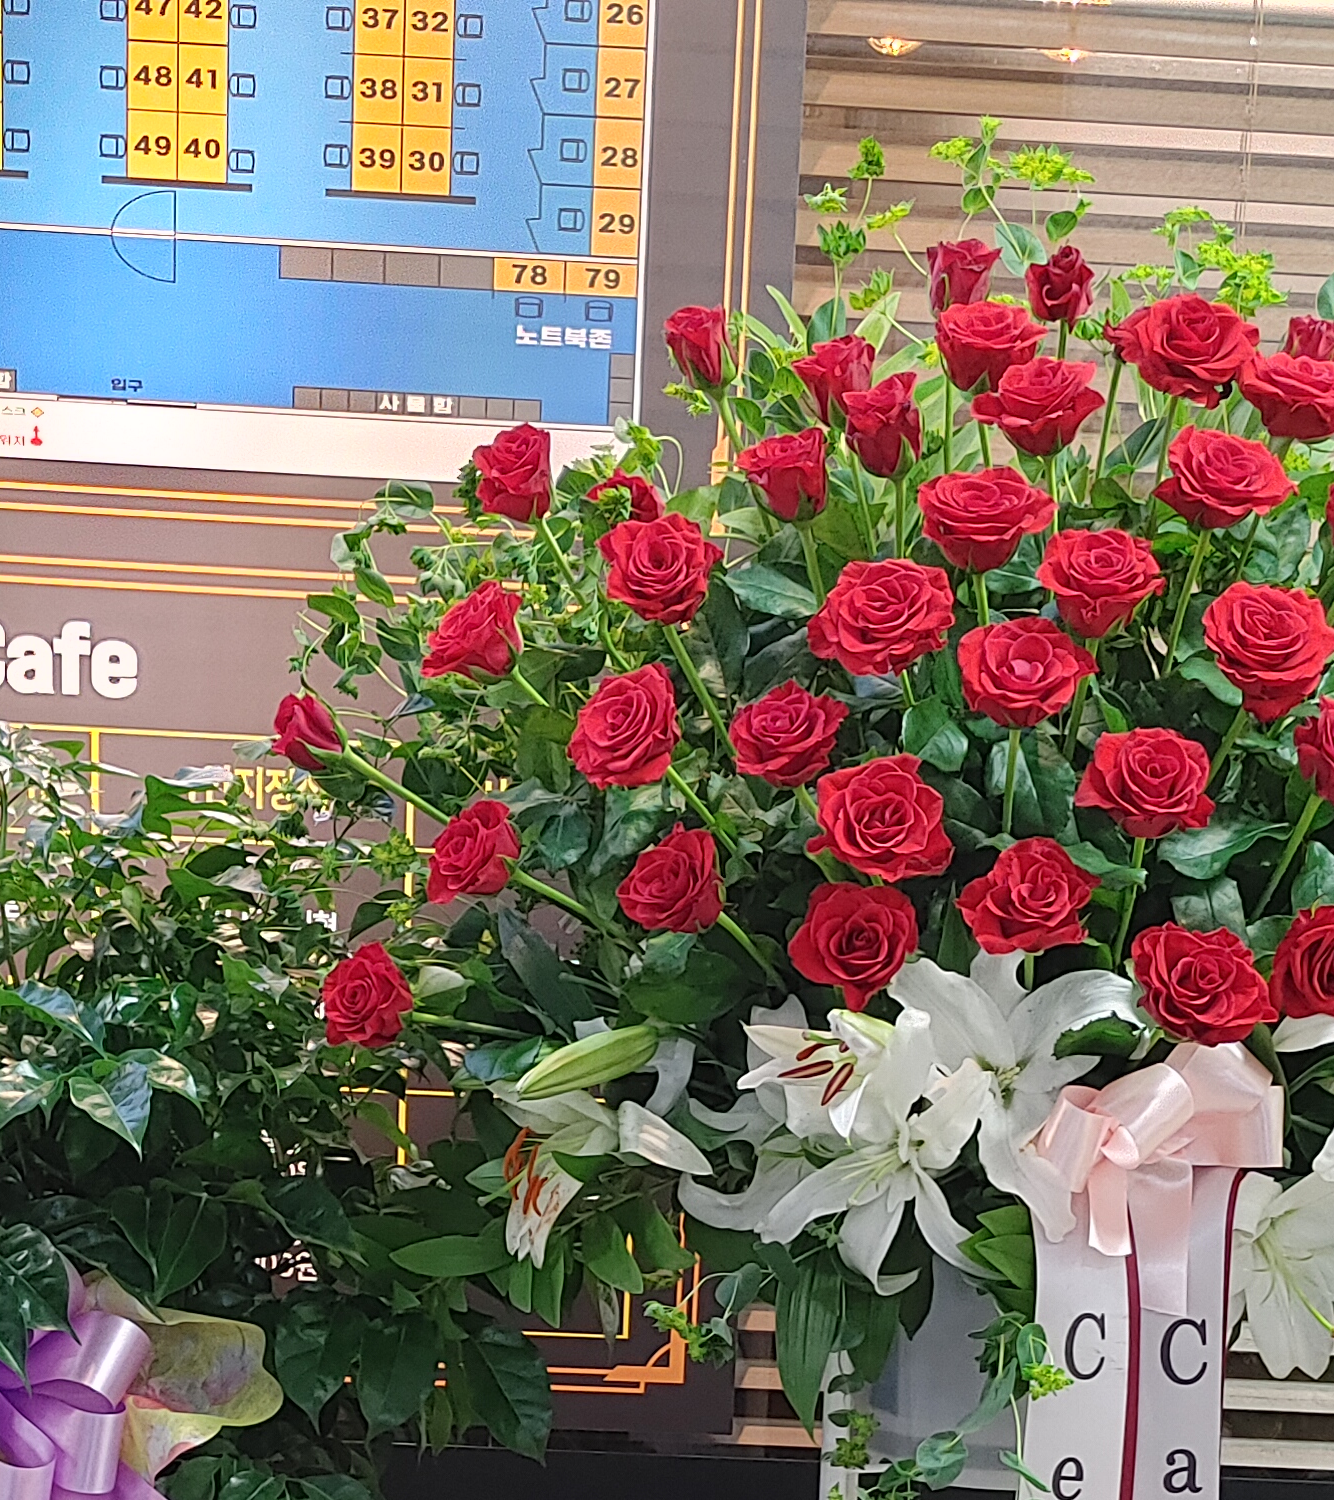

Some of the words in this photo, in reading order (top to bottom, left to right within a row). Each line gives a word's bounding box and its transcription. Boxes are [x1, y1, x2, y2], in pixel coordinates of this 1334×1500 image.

[134, 0, 168, 18] 47
[184, 0, 222, 20] 42
[362, 8, 399, 29] 37
[411, 11, 449, 32] 32
[606, 3, 643, 25] 26
[134, 66, 171, 87] 48
[185, 68, 218, 90] 41
[604, 77, 640, 99] 27
[360, 78, 397, 99] 38
[411, 81, 444, 103] 31
[134, 135, 171, 156] 49
[184, 137, 220, 159] 40
[600, 146, 638, 168] 28
[358, 147, 396, 169] 39
[408, 150, 445, 172] 30
[598, 212, 635, 234] 29
[512, 265, 547, 285] 78
[585, 268, 620, 289] 79
[515, 325, 612, 349] 노트북존
[111, 377, 143, 393] 입구
